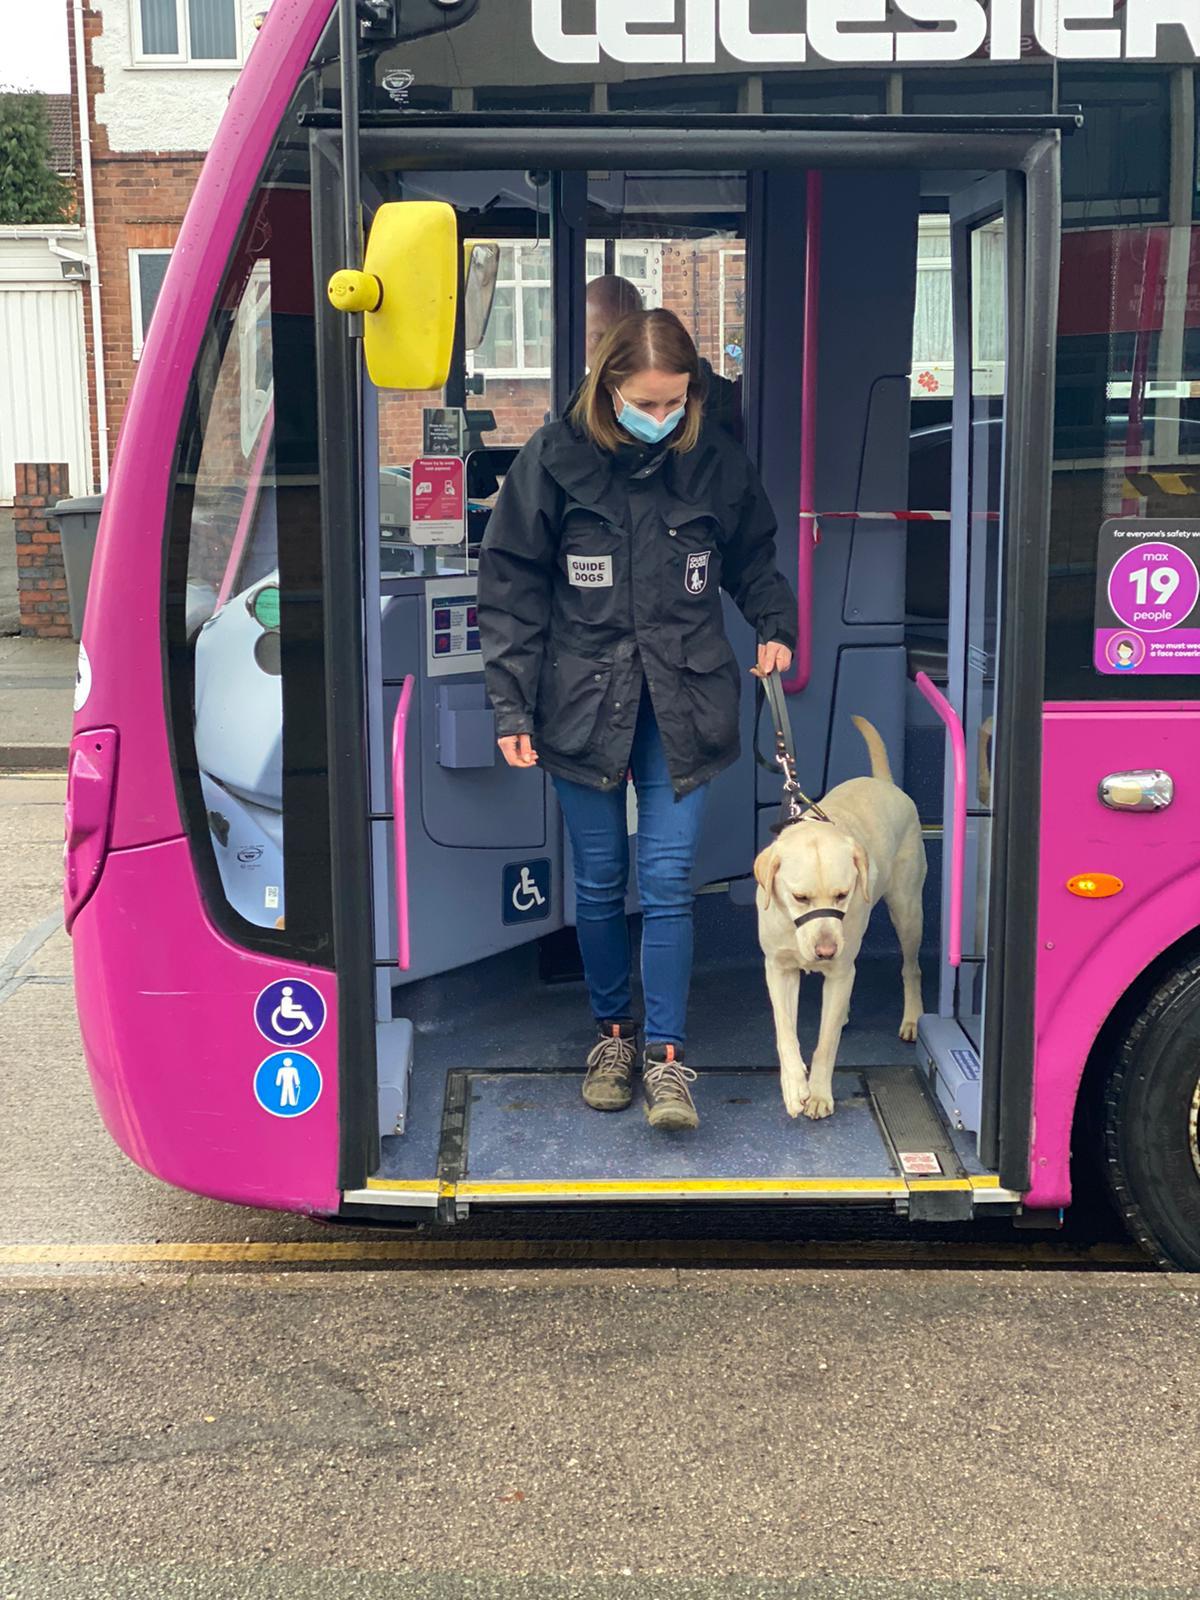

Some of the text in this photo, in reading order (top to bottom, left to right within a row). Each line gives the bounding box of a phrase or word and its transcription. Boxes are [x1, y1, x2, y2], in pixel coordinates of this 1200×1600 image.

[1126, 530, 1165, 539] everyone's
[1167, 530, 1190, 538] safety
[1143, 553, 1168, 561] max
[572, 561, 605, 571] GUIDE
[575, 572, 604, 582] DOGS
[1129, 567, 1180, 605] 19
[1133, 609, 1172, 622] people
